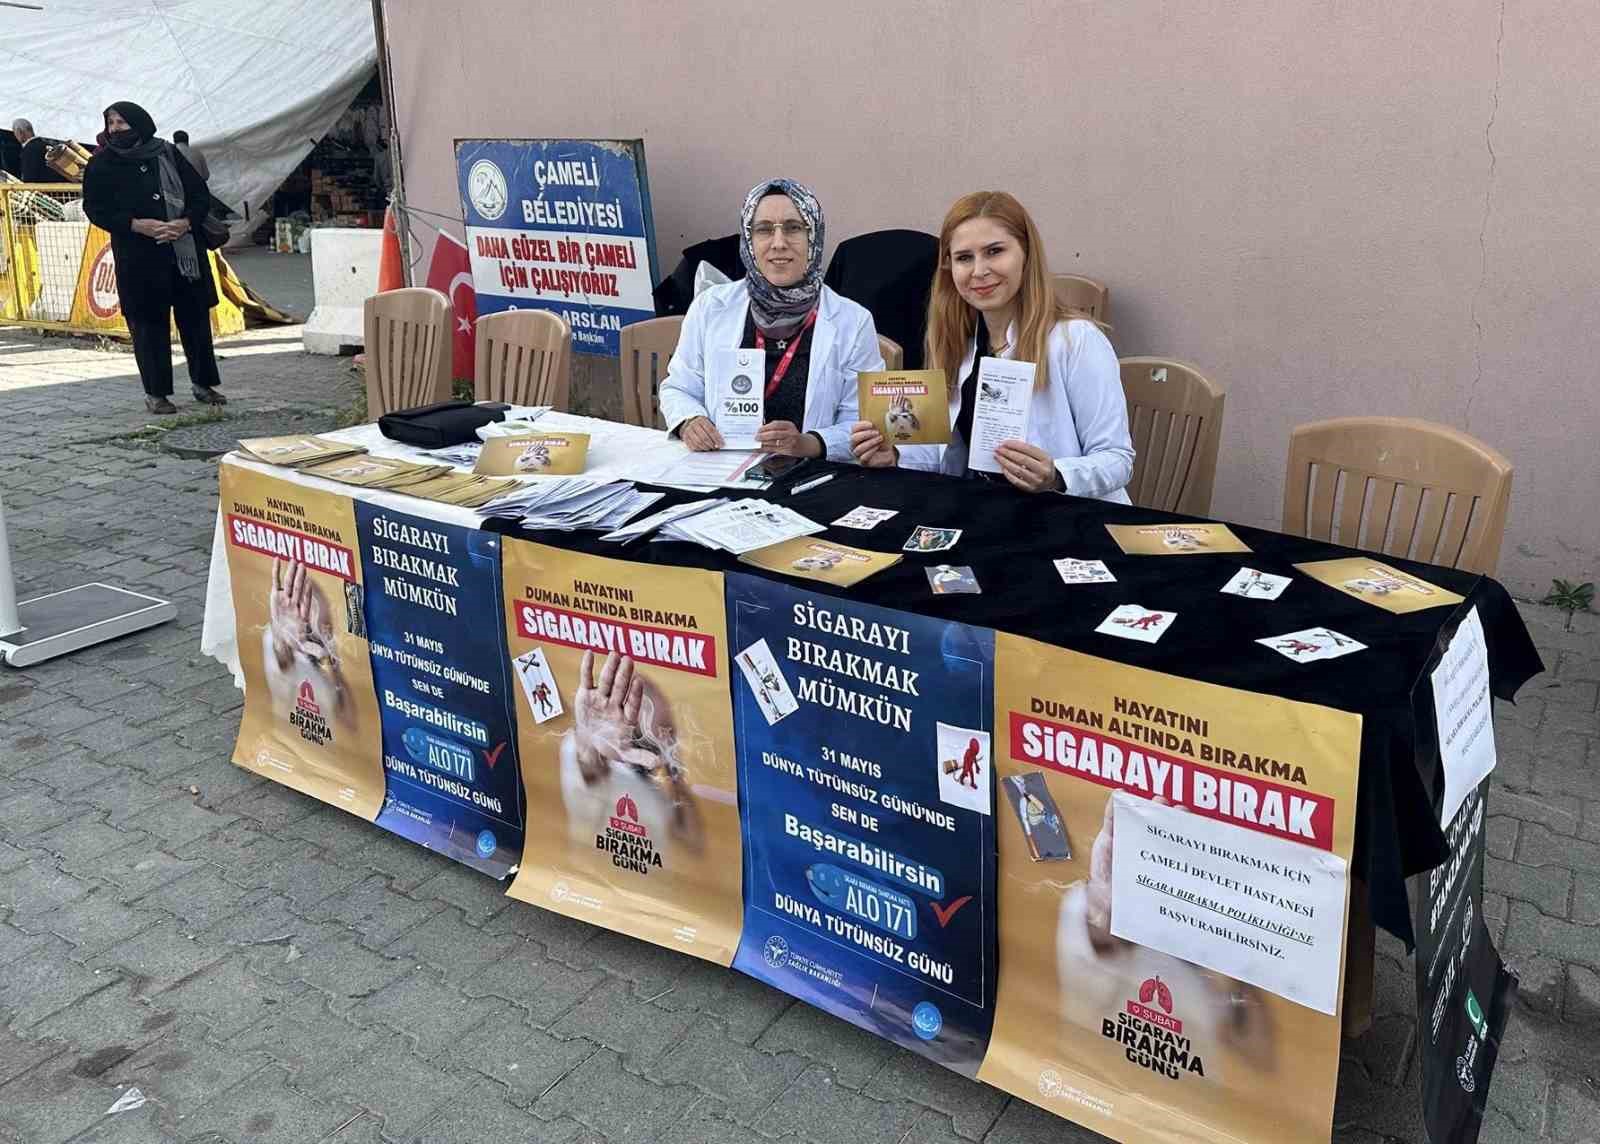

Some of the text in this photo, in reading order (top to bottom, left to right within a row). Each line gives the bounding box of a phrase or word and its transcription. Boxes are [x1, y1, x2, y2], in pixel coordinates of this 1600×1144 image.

[534, 156, 600, 190] ÇAMELİ
[521, 195, 624, 229] BELEDİYESİ
[476, 233, 637, 270] DAHA GÜZEL BİR ÇAMELİ
[95, 262, 116, 293] DU
[499, 260, 620, 297] İÇİN ÇALIŞIYORUZ
[234, 502, 342, 544] DUMAN ALTINDA BIRAKMA
[266, 497, 305, 517] HAYATINI
[373, 514, 451, 555] SİGARAYI
[303, 540, 350, 577] BIRAK
[372, 546, 460, 588] BIRAKMAK
[384, 577, 458, 617] MÜMKÜN
[525, 586, 698, 629] DUMAN ALTINDA BIRAKMA
[573, 580, 634, 602] HAYATINI
[403, 631, 444, 655] 31 MAYIS
[793, 600, 911, 654] SİGARAYI
[629, 629, 707, 670] BIRAK
[787, 637, 920, 697] BIRAKMAK
[394, 650, 442, 676] TÜTÜNSÜZ
[443, 666, 490, 694] GÜNÜ'NDE
[411, 678, 445, 699] SEN DE
[384, 689, 487, 742] Başarabilirsin
[797, 676, 913, 732] MÜMKÜN
[1114, 696, 1208, 738] HAYATINI
[290, 711, 332, 740] BIRAKMA
[1030, 697, 1307, 786] DUMAN ALTINDA BIRAKMA
[428, 743, 451, 771] ALO
[453, 752, 473, 781] 171
[821, 746, 882, 779] 31 MAYIS
[385, 754, 502, 813] DÜNYA TÜTÜNSÜZ GÜNÜ
[761, 750, 956, 832] DÜNYA TÜTÜNSÜZ GÜNÜ'NDE
[831, 803, 879, 833] SEN DE
[1193, 774, 1318, 840] BIRAK
[596, 834, 663, 868] BIRAKMA
[612, 854, 648, 875] GÜNÜ
[785, 813, 941, 893] Başarabilirsin
[1146, 824, 1311, 885] SİGARAYI BIRAKMAK İÇİN
[1136, 874, 1174, 895] SİGARA
[1176, 888, 1224, 913] BIRAKMA
[1140, 850, 1314, 918] ÇAMELİ DEVLET HASTANESİ
[845, 886, 912, 937] ALO 171
[775, 893, 954, 985] DÜNYA TÜTÜNSÜZ GÜNÜ
[1101, 1018, 1205, 1077] BIRAKMA
[1125, 1046, 1180, 1081] GÜNÜ
